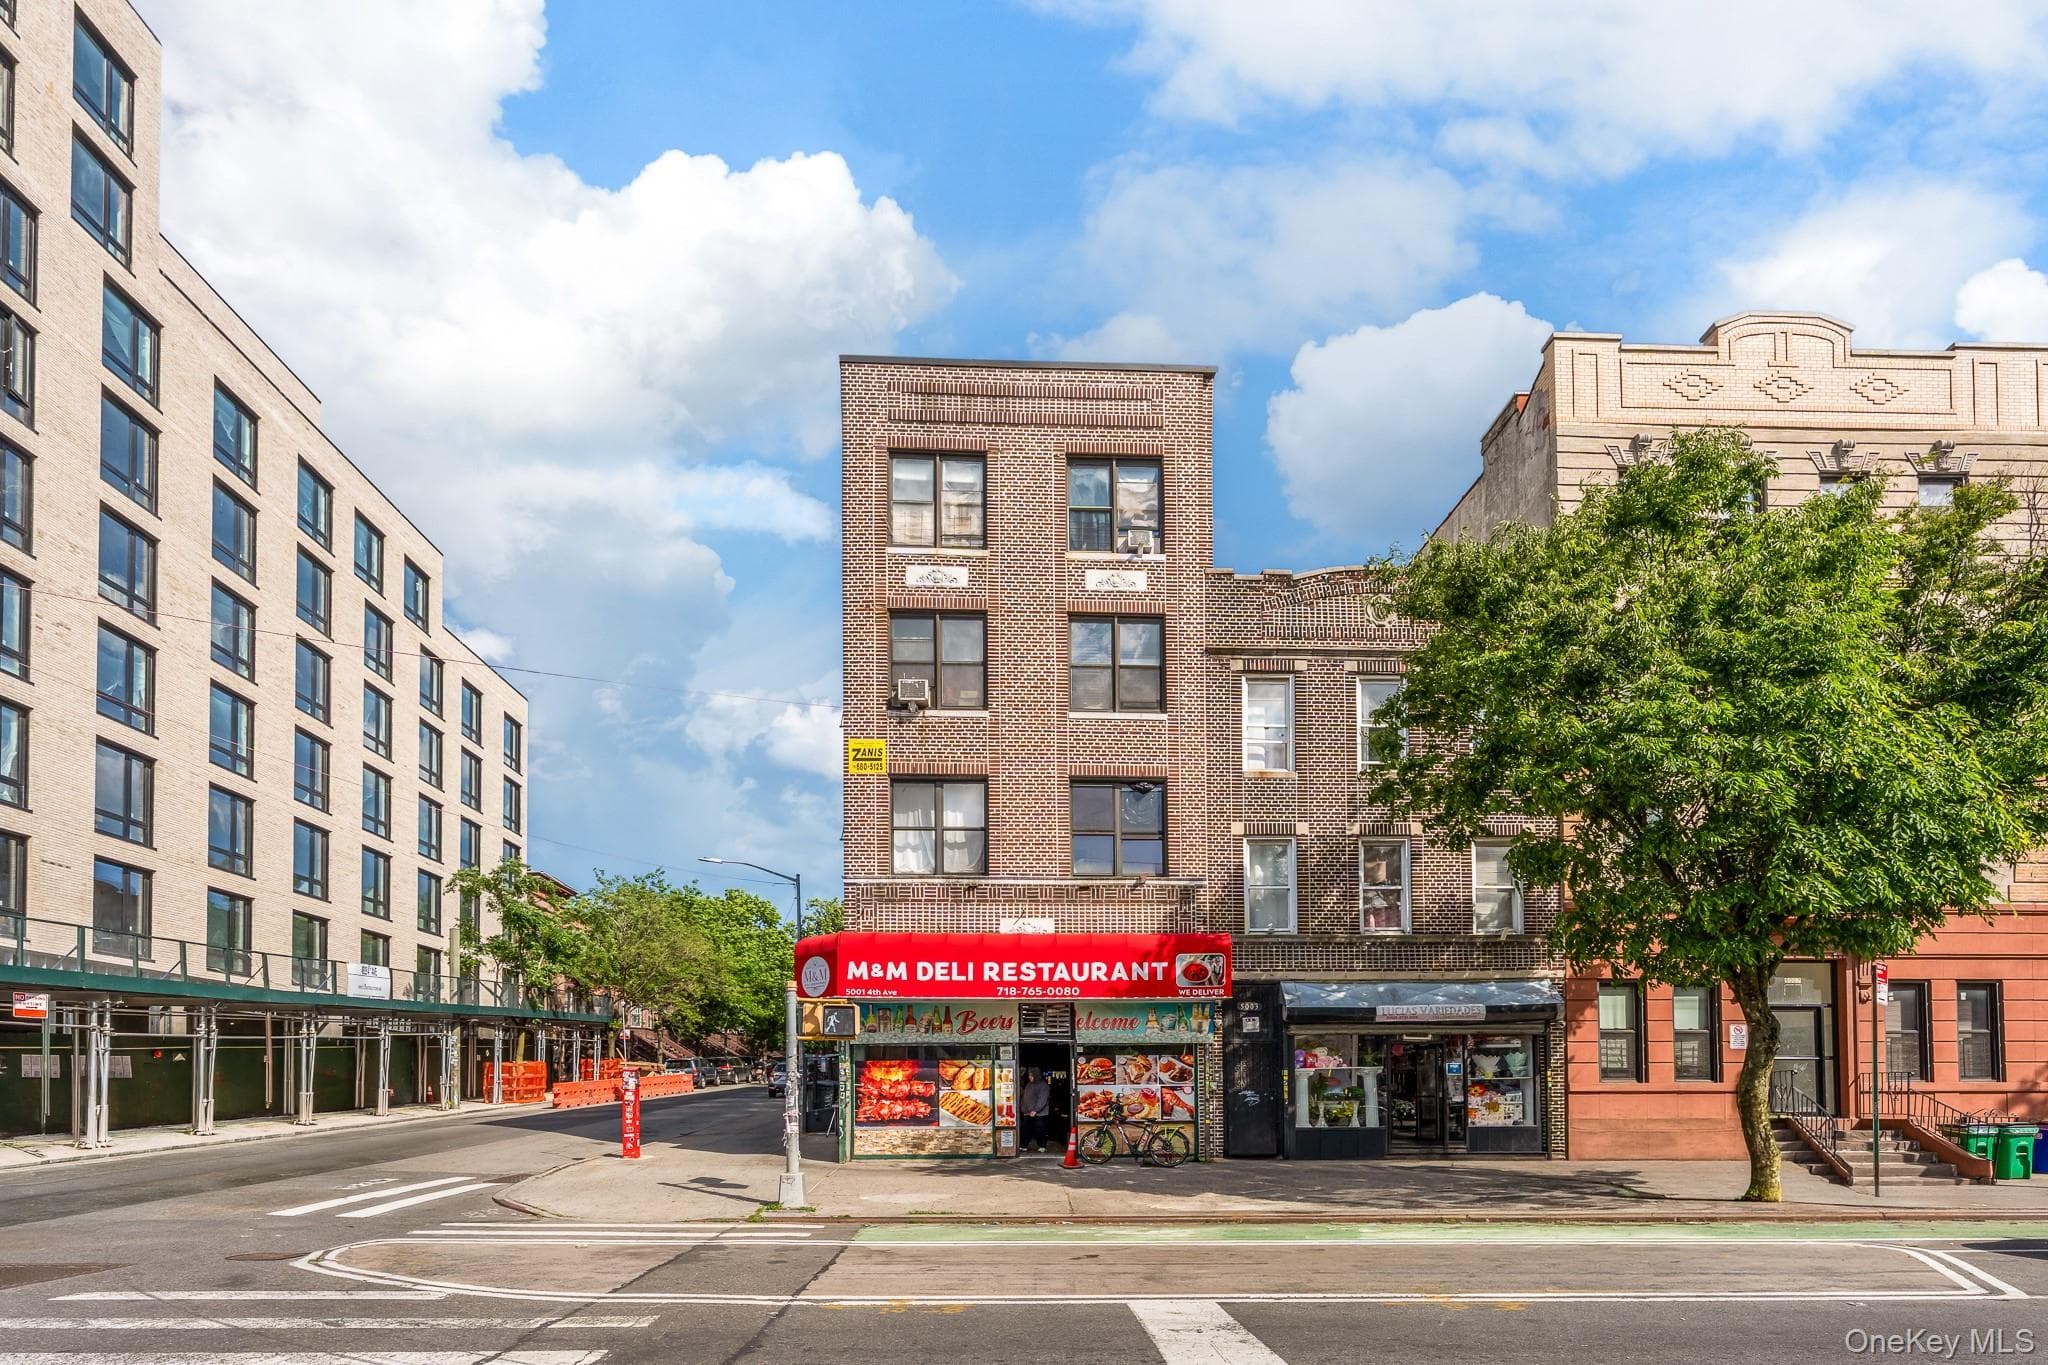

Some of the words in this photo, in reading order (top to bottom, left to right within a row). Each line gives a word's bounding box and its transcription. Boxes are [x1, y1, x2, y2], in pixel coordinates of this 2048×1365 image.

[852, 748, 883, 761] ZANIS
[804, 967, 828, 983] M&M
[847, 961, 908, 981] M&M
[916, 961, 974, 981] DELI
[983, 961, 1168, 982] RESTAURANT
[845, 988, 866, 996] 5001
[866, 988, 882, 996] 4th
[882, 988, 897, 996] Ave
[996, 986, 1080, 996] 718-765-0080
[1192, 988, 1224, 996] DELIVER
[1240, 1002, 1259, 1010] 5003
[955, 1010, 1016, 1036] Beers
[1074, 1009, 1140, 1031] elcome
